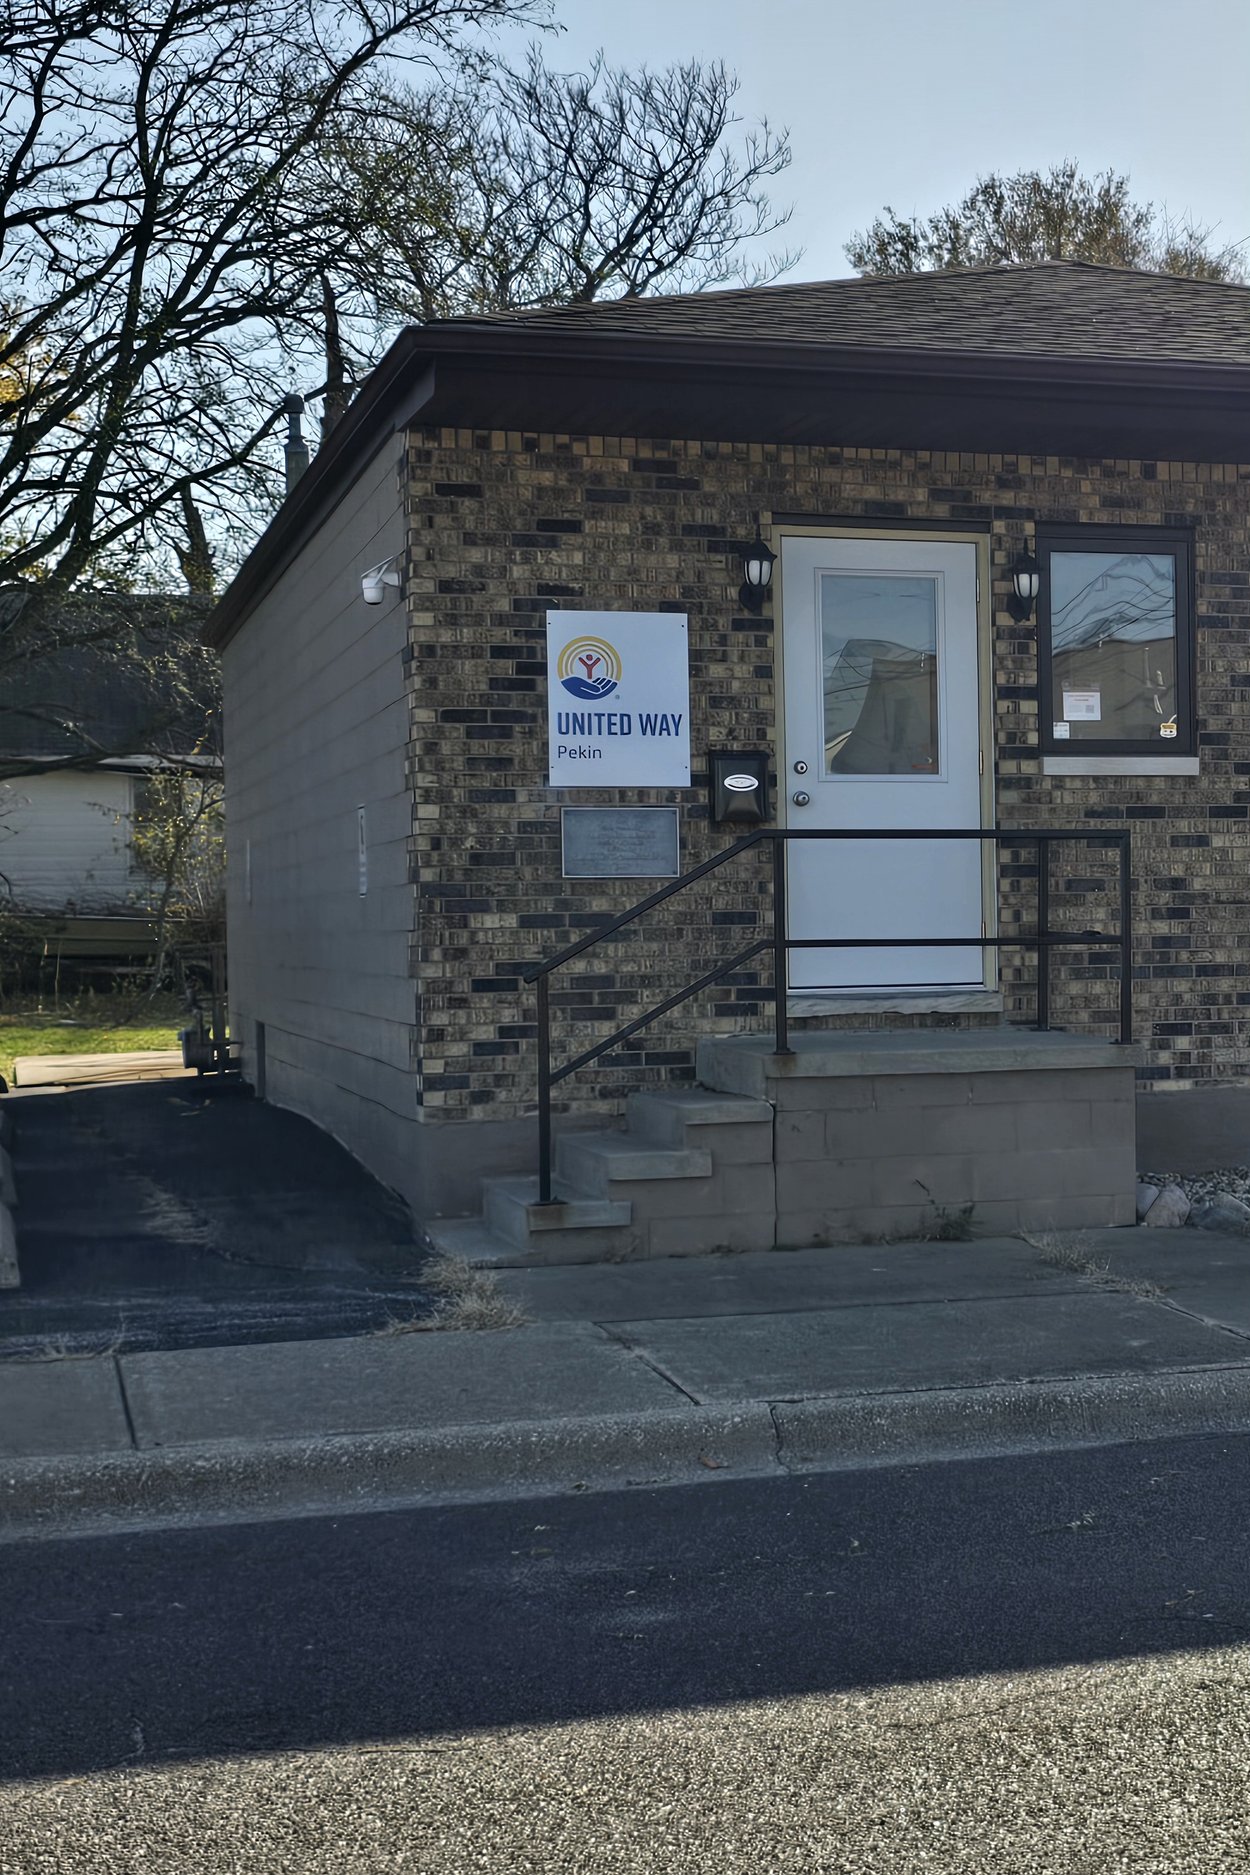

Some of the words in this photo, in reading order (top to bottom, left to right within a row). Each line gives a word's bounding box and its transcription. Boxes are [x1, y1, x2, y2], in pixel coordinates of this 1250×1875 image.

[557, 712, 632, 736] UNITED
[638, 713, 682, 737] WAY
[557, 745, 602, 759] Pekin
